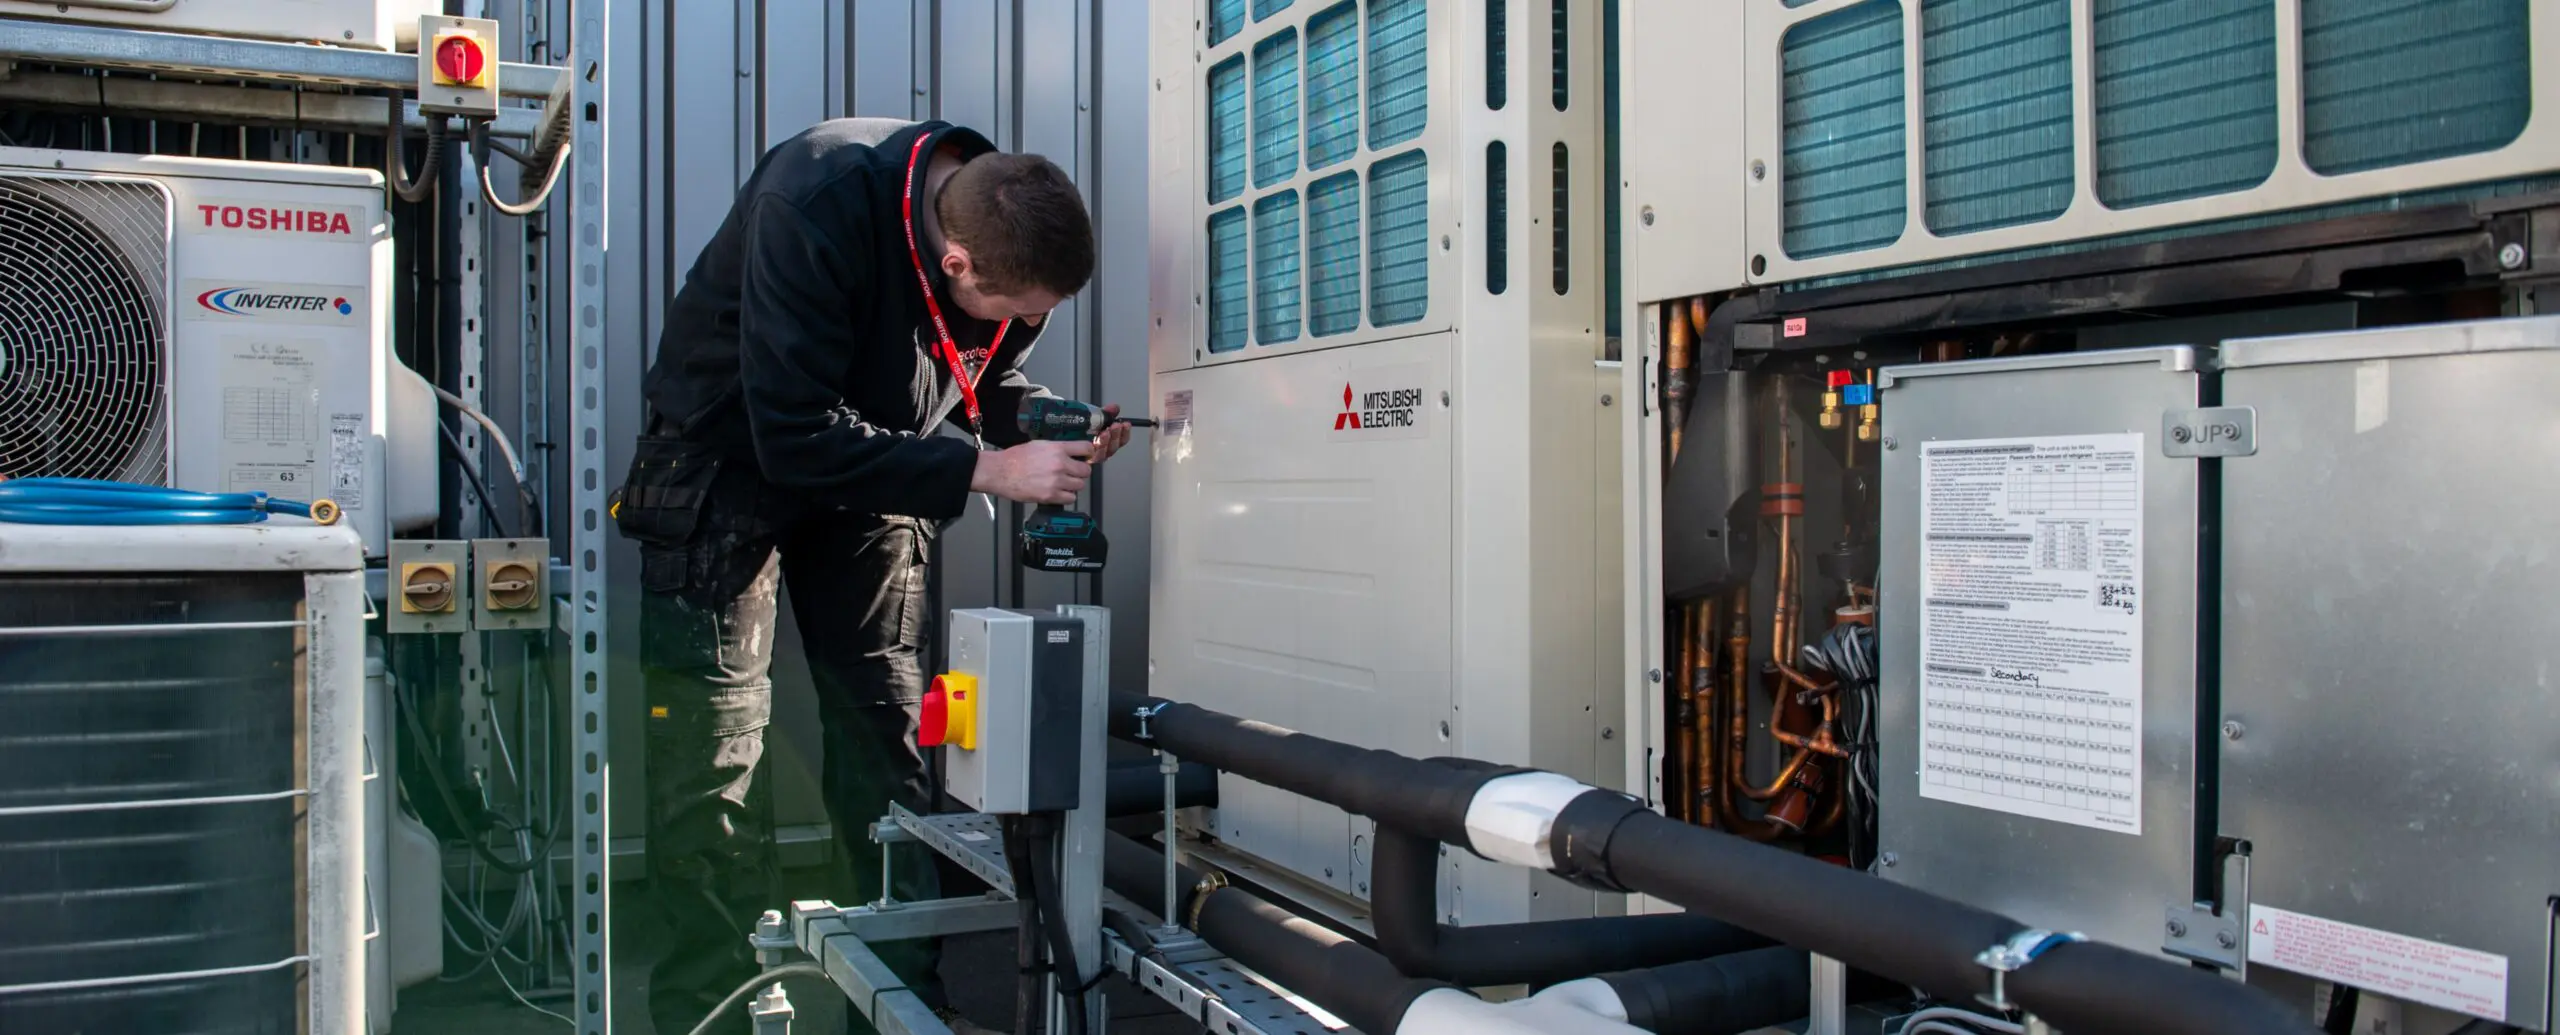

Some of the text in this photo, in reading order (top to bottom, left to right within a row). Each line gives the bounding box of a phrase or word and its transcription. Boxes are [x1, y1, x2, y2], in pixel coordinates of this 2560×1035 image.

[198, 204, 351, 234] TOSHIBA
[917, 268, 932, 297] VISITOR
[234, 293, 328, 311] INVERTER
[934, 314, 950, 344] VISITOR
[957, 345, 988, 361] ecote
[952, 360, 968, 389] VISITOR
[1364, 388, 1422, 410] MITSUBISHI
[1364, 408, 1414, 428] ELECTRIC
[2194, 424, 2222, 444] UP
[280, 472, 294, 482] 63
[1991, 666, 2039, 688] Secondary
